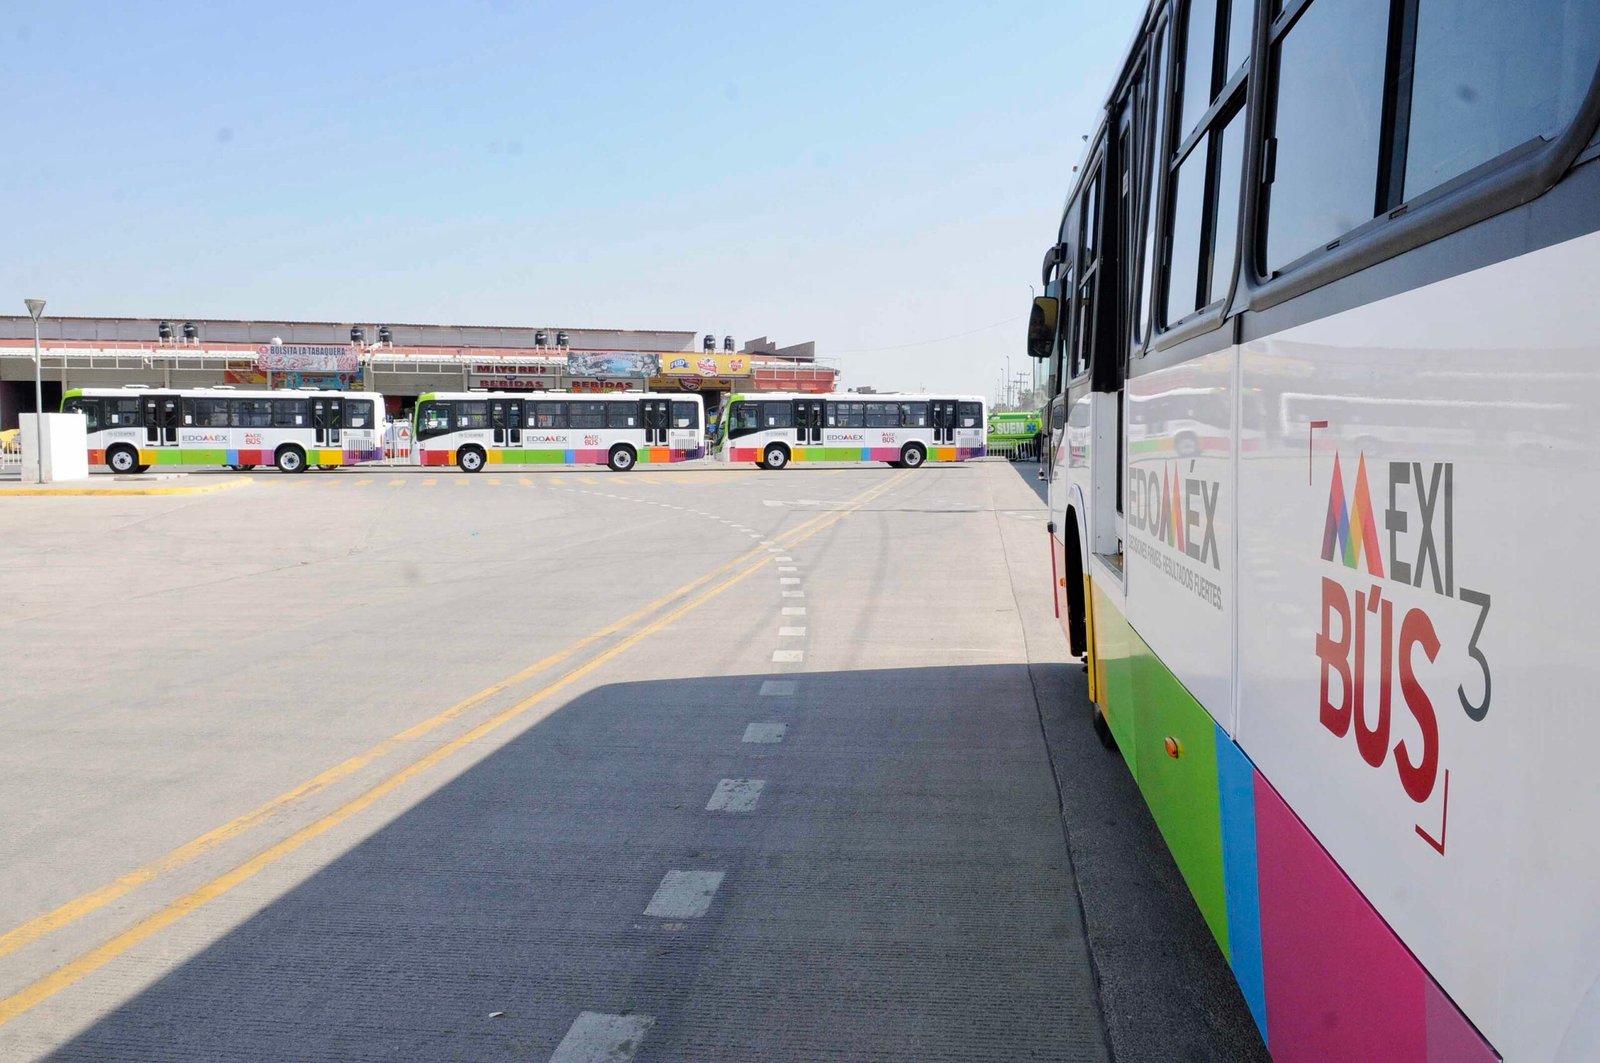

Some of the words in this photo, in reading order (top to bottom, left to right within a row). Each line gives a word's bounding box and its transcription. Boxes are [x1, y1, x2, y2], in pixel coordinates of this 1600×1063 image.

[270, 346, 297, 355] BOLSITA
[299, 346, 307, 355] LA
[308, 346, 346, 356] TABAQUERA
[476, 365, 547, 374] MAYOREO
[480, 380, 545, 388] BEBIDAS
[572, 380, 634, 389] BEBIDAS
[996, 422, 1025, 434] SUEM
[1128, 459, 1221, 572] EDOMÉX
[1320, 450, 1454, 598] MEXI
[1162, 555, 1194, 592] RESULTADOS
[1457, 587, 1492, 723] 3
[1315, 577, 1441, 804] BÚS
